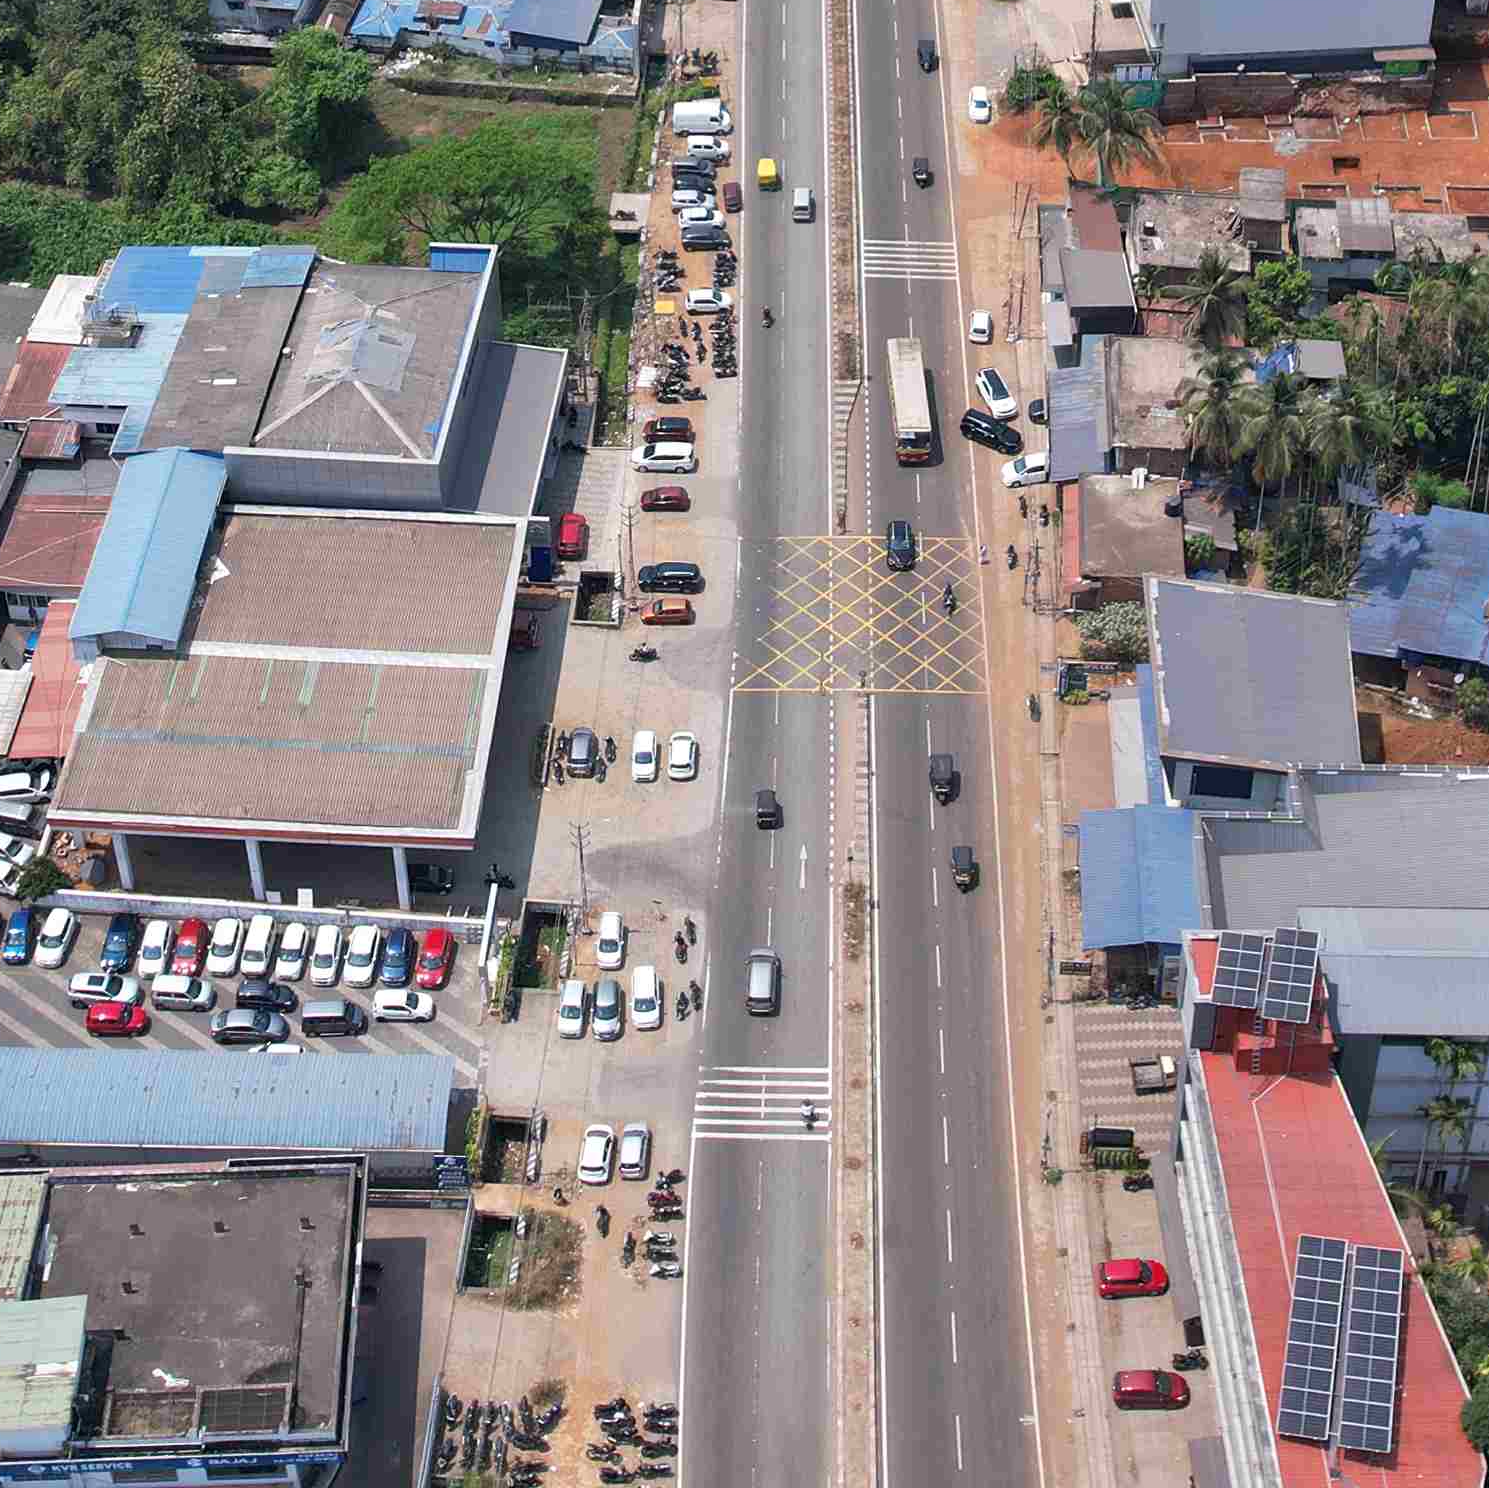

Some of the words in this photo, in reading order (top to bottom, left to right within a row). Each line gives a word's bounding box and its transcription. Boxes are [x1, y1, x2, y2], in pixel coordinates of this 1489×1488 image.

[208, 1457, 257, 1465] BAJAJ
[51, 1464, 79, 1473] KVR
[80, 1462, 134, 1472] SERVICE
